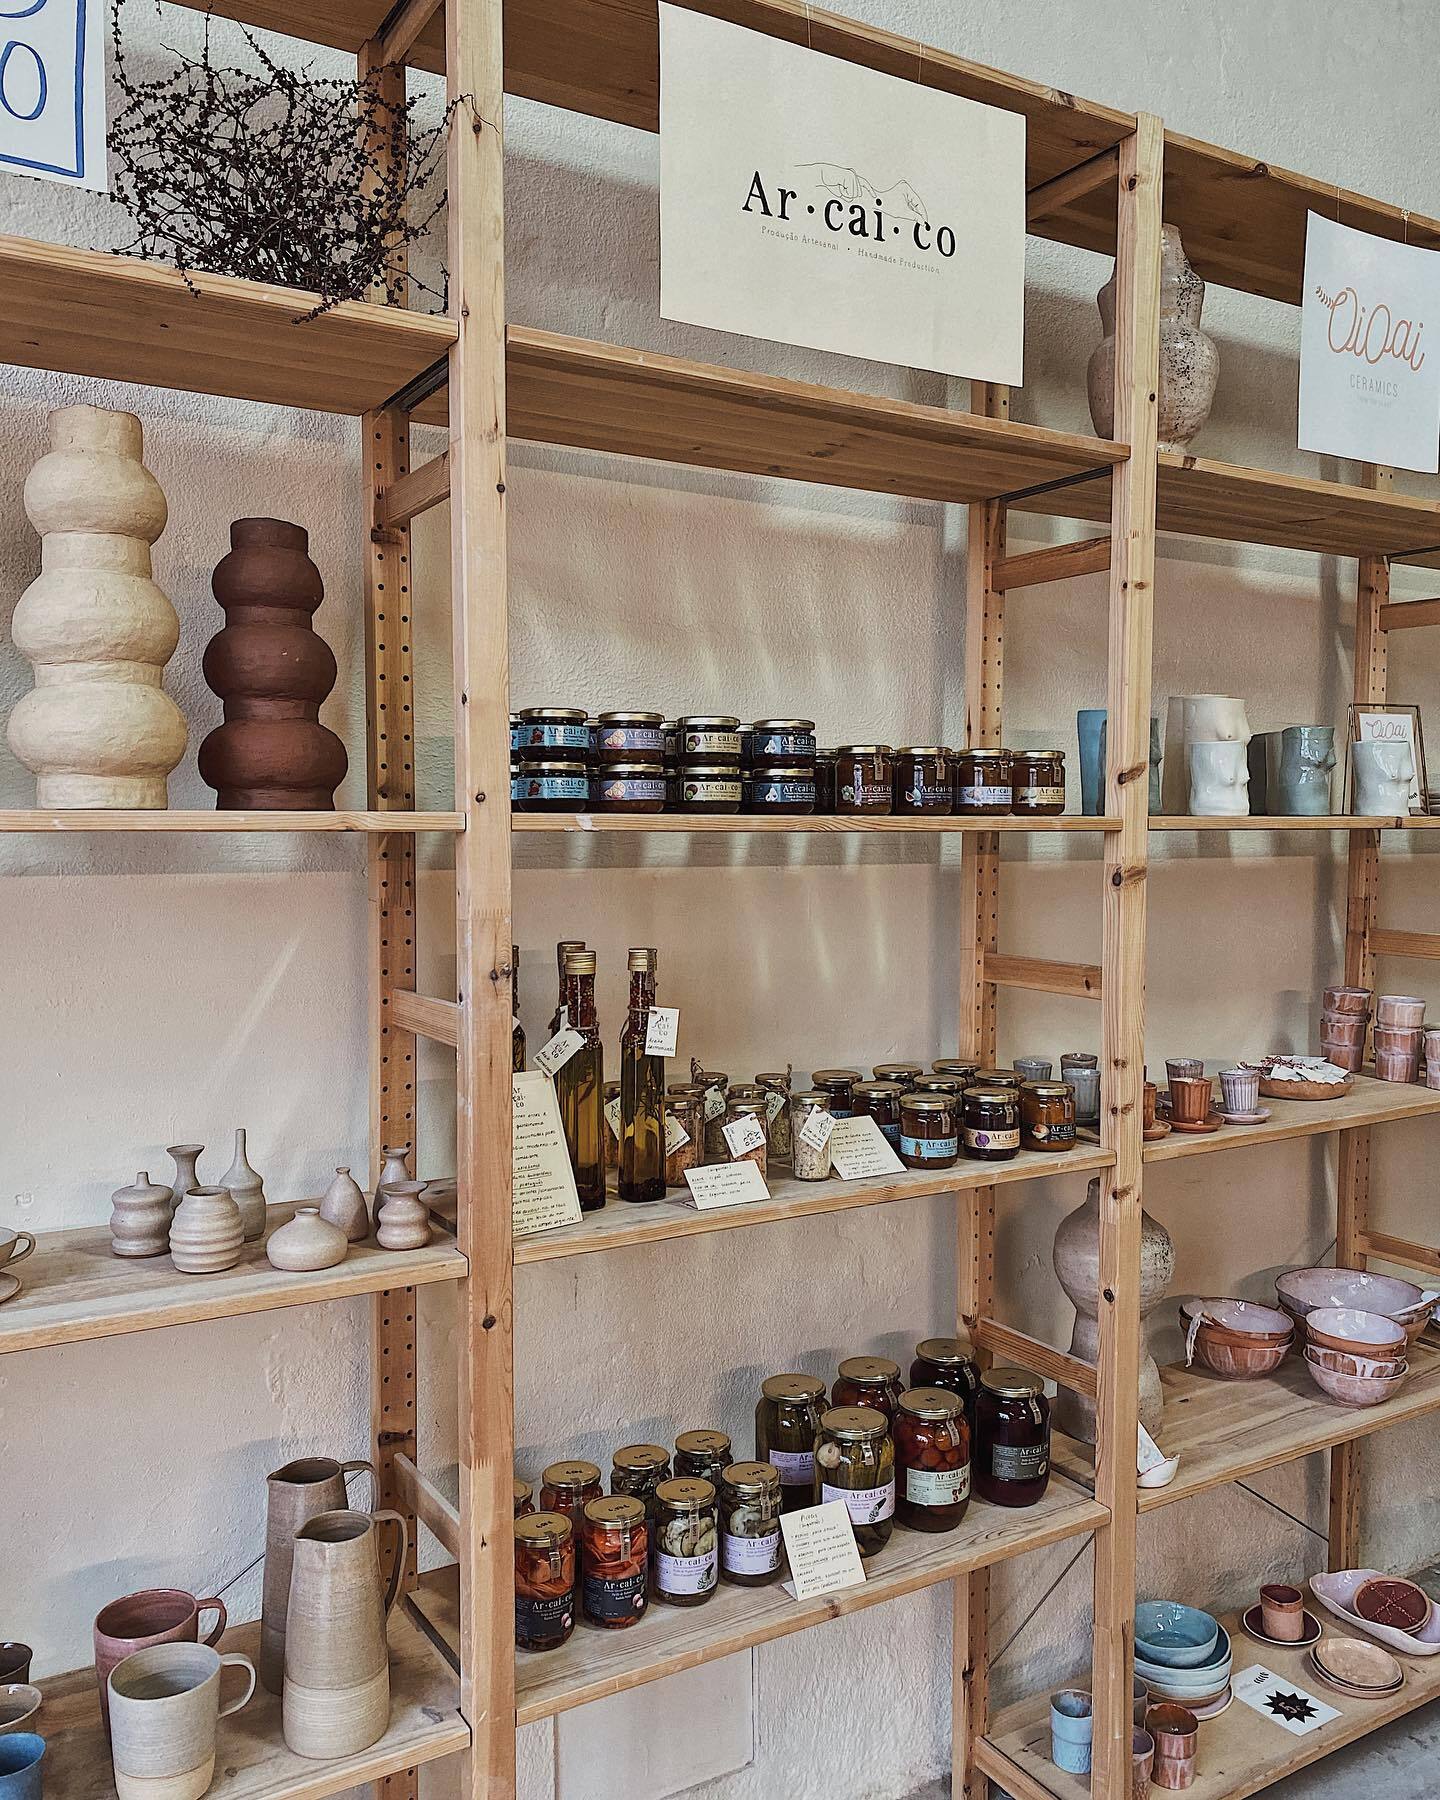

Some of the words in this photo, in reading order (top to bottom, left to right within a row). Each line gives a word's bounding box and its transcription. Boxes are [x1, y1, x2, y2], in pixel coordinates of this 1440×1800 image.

[761, 226, 799, 241] Produção
[802, 234, 839, 251] Artesanal
[858, 248, 897, 264] Handmade
[899, 257, 940, 274] Production
[1351, 374, 1399, 398] CERAMICS
